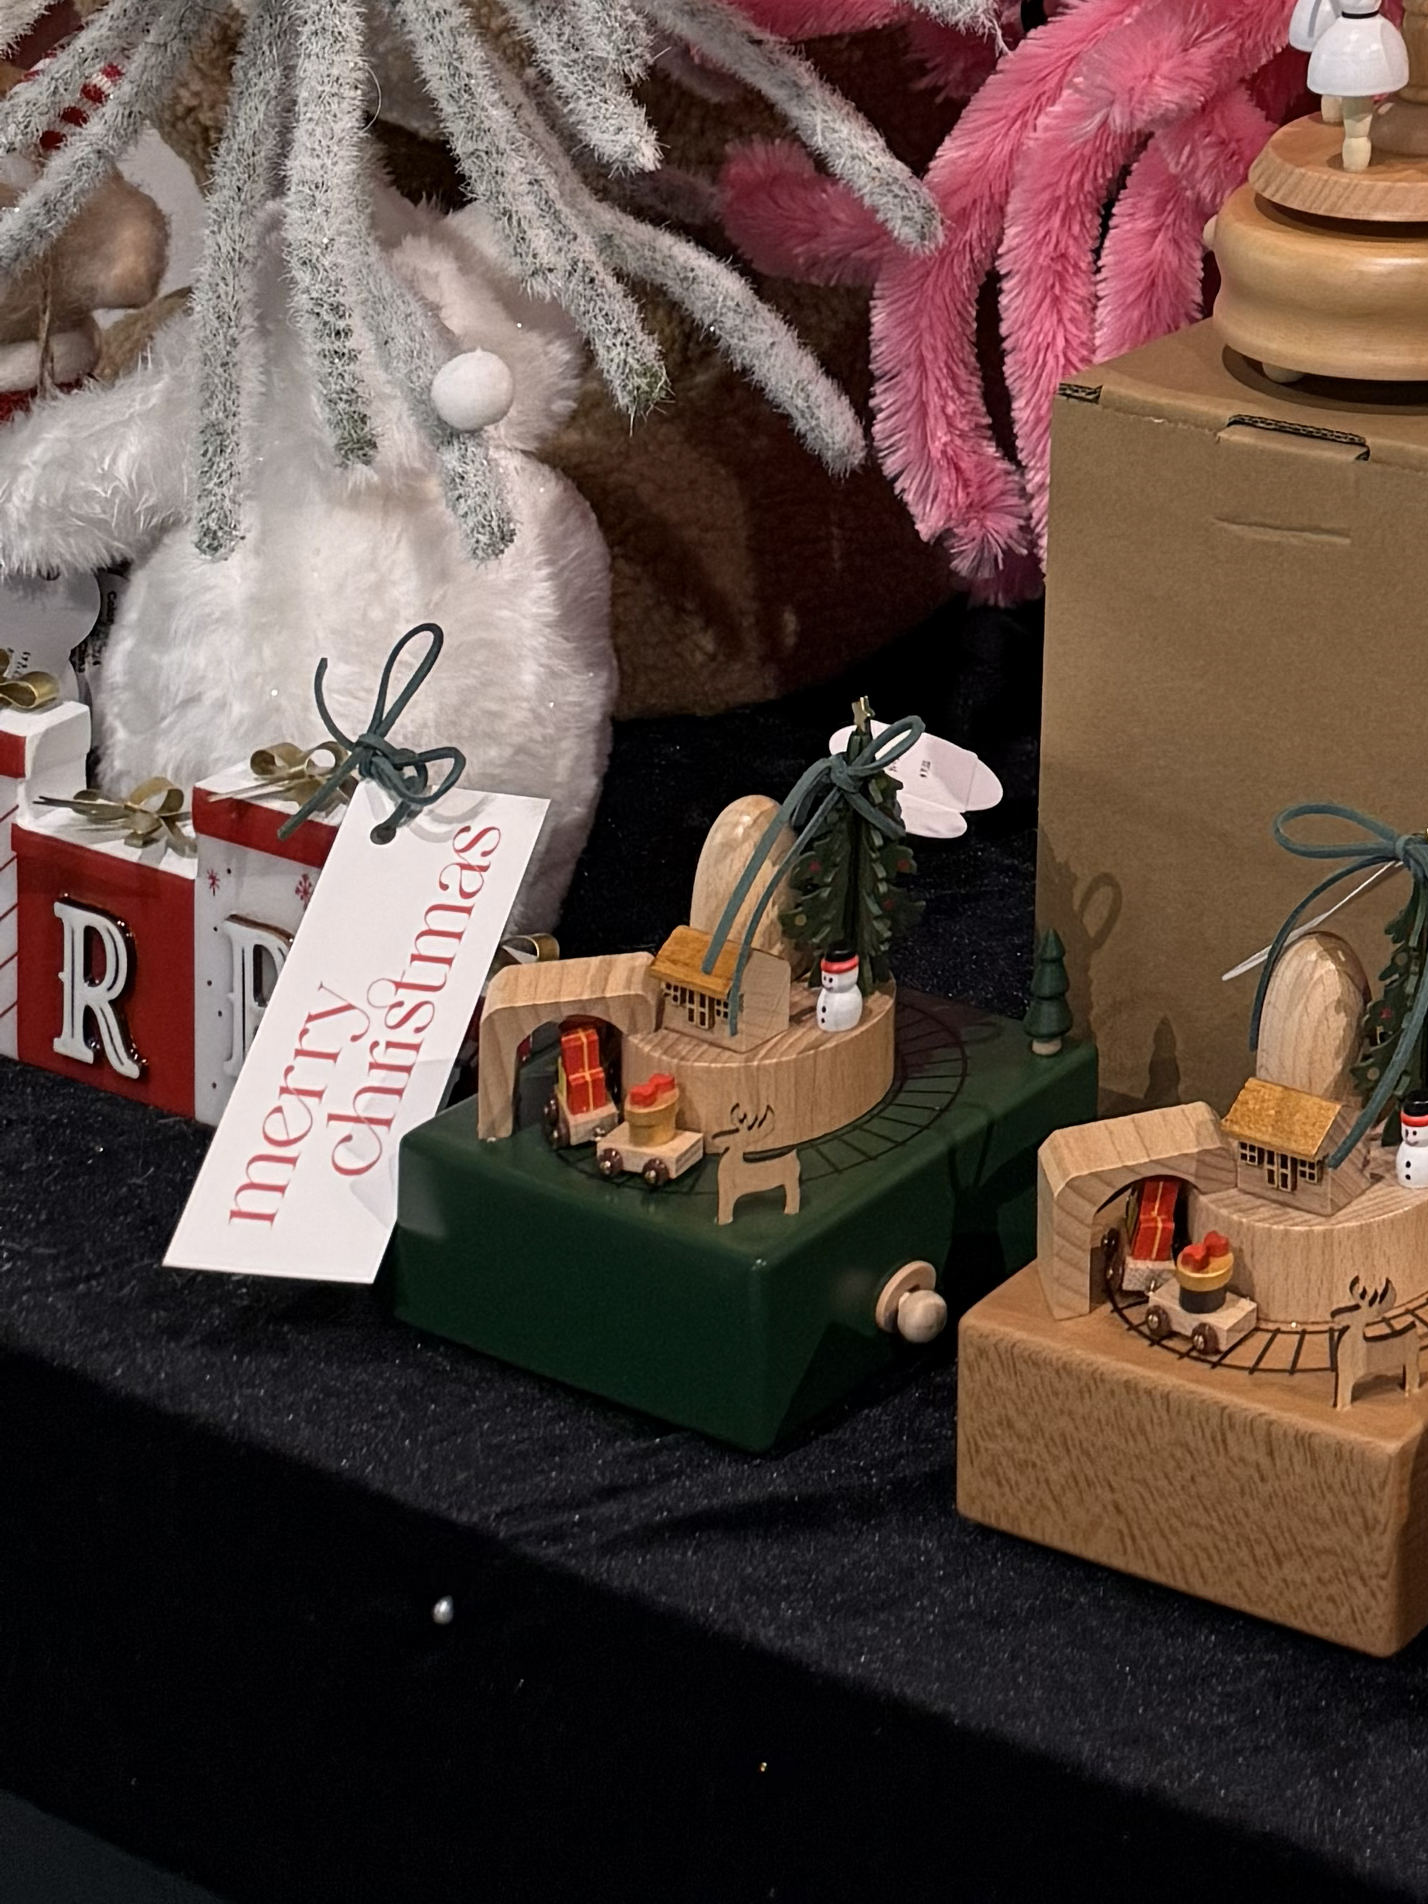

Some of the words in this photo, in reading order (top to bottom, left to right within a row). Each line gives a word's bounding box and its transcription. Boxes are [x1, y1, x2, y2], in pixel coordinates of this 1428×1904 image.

[52, 898, 142, 1081] R
[228, 981, 370, 1227] merry
[330, 824, 502, 1177] christmas
